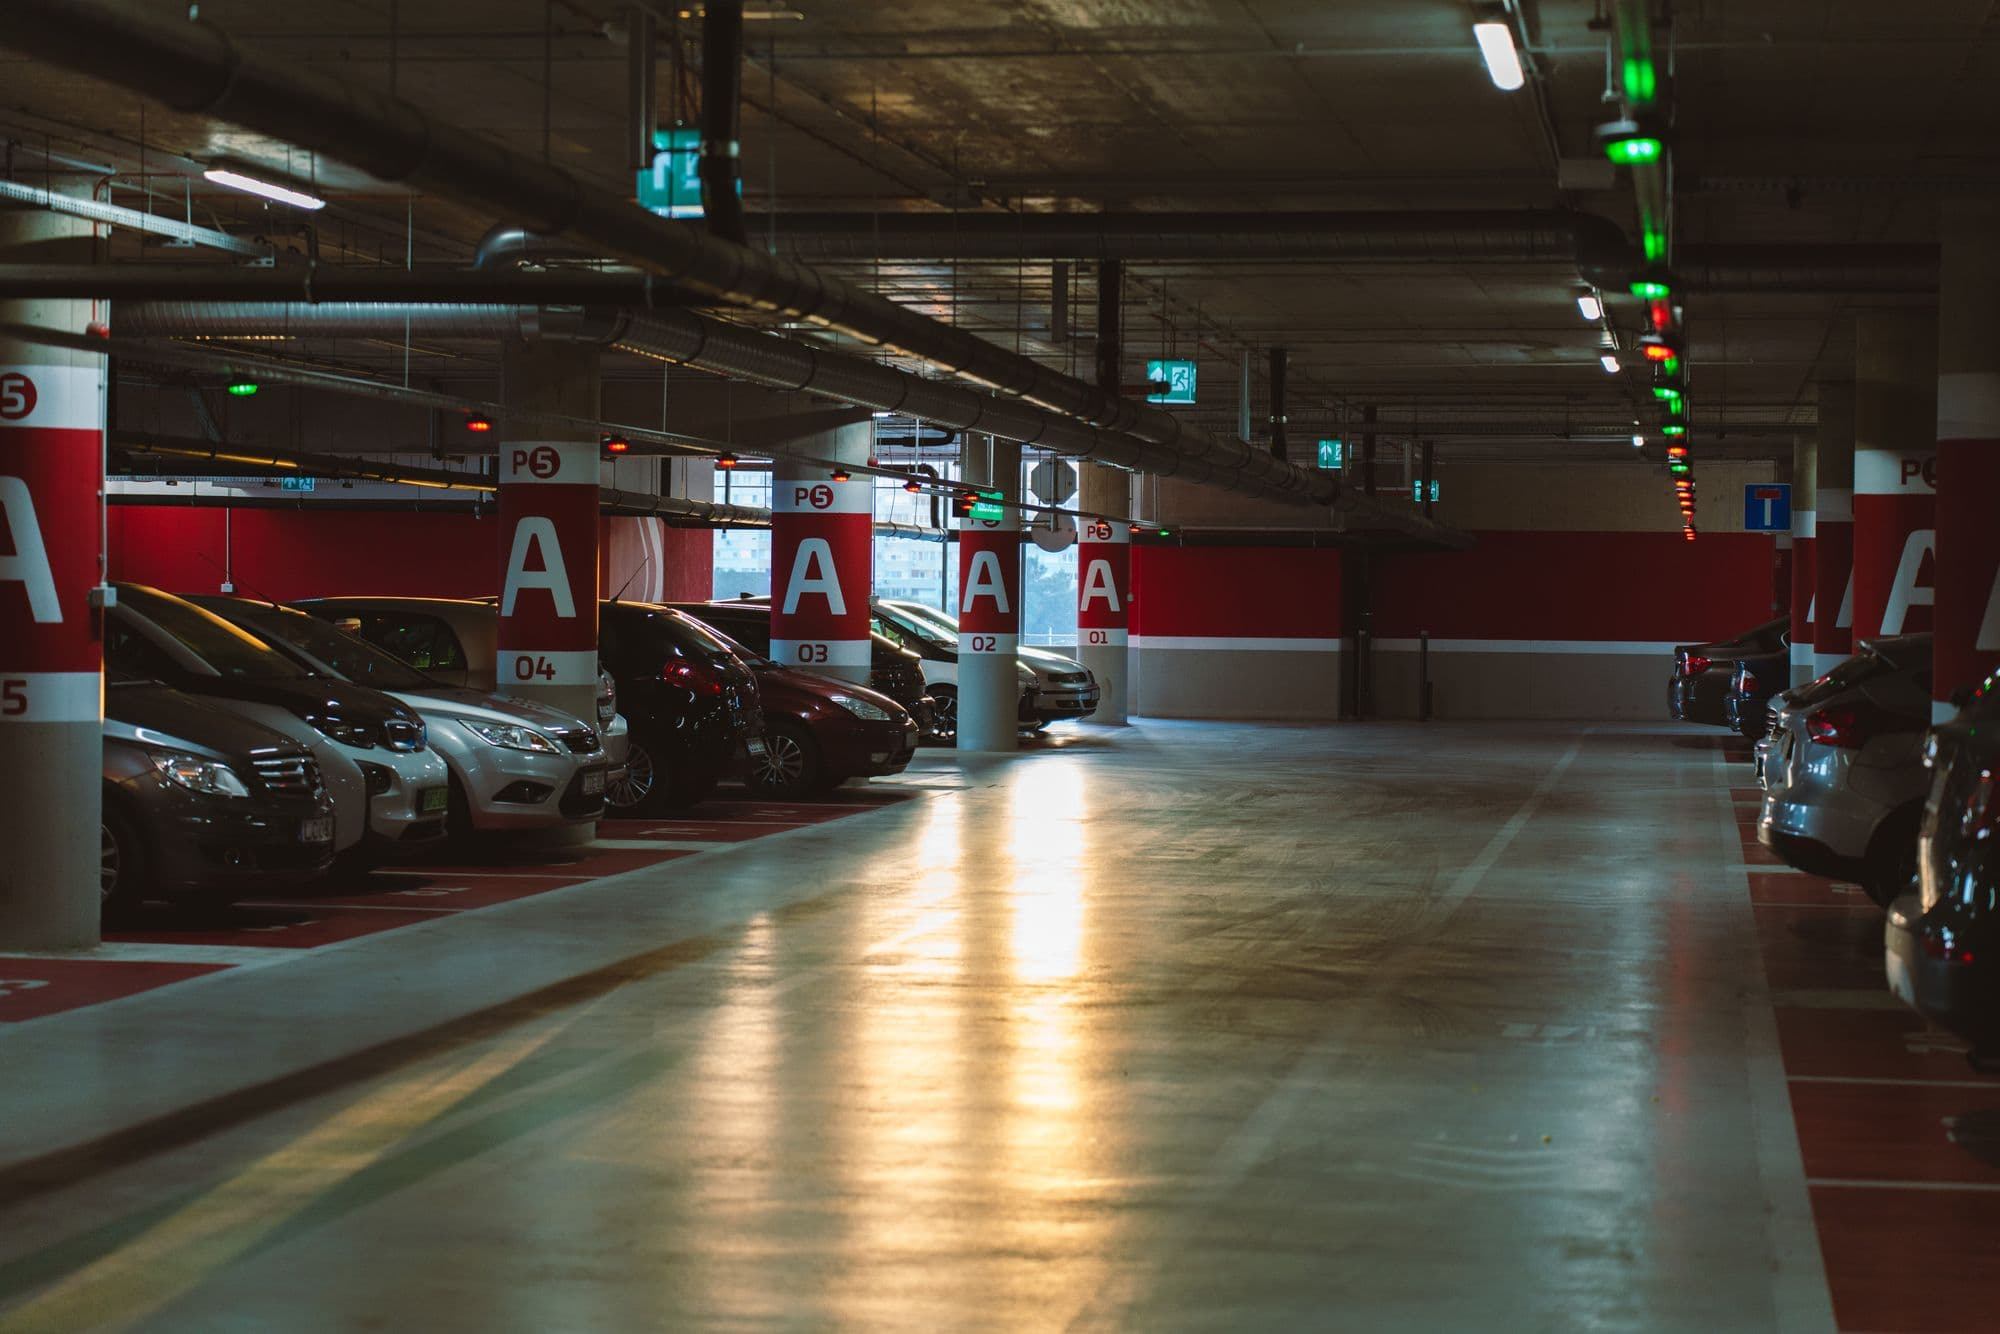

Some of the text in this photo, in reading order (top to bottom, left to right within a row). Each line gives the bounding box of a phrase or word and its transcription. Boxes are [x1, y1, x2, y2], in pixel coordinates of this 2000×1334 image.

[1901, 458, 1936, 488] P
[501, 516, 577, 618] A
[782, 537, 847, 615] A
[962, 551, 1010, 614] A
[1080, 559, 1120, 612] A
[972, 637, 996, 651] 02
[1089, 631, 1108, 644] 01
[515, 656, 555, 681] 04
[798, 644, 828, 663] 03
